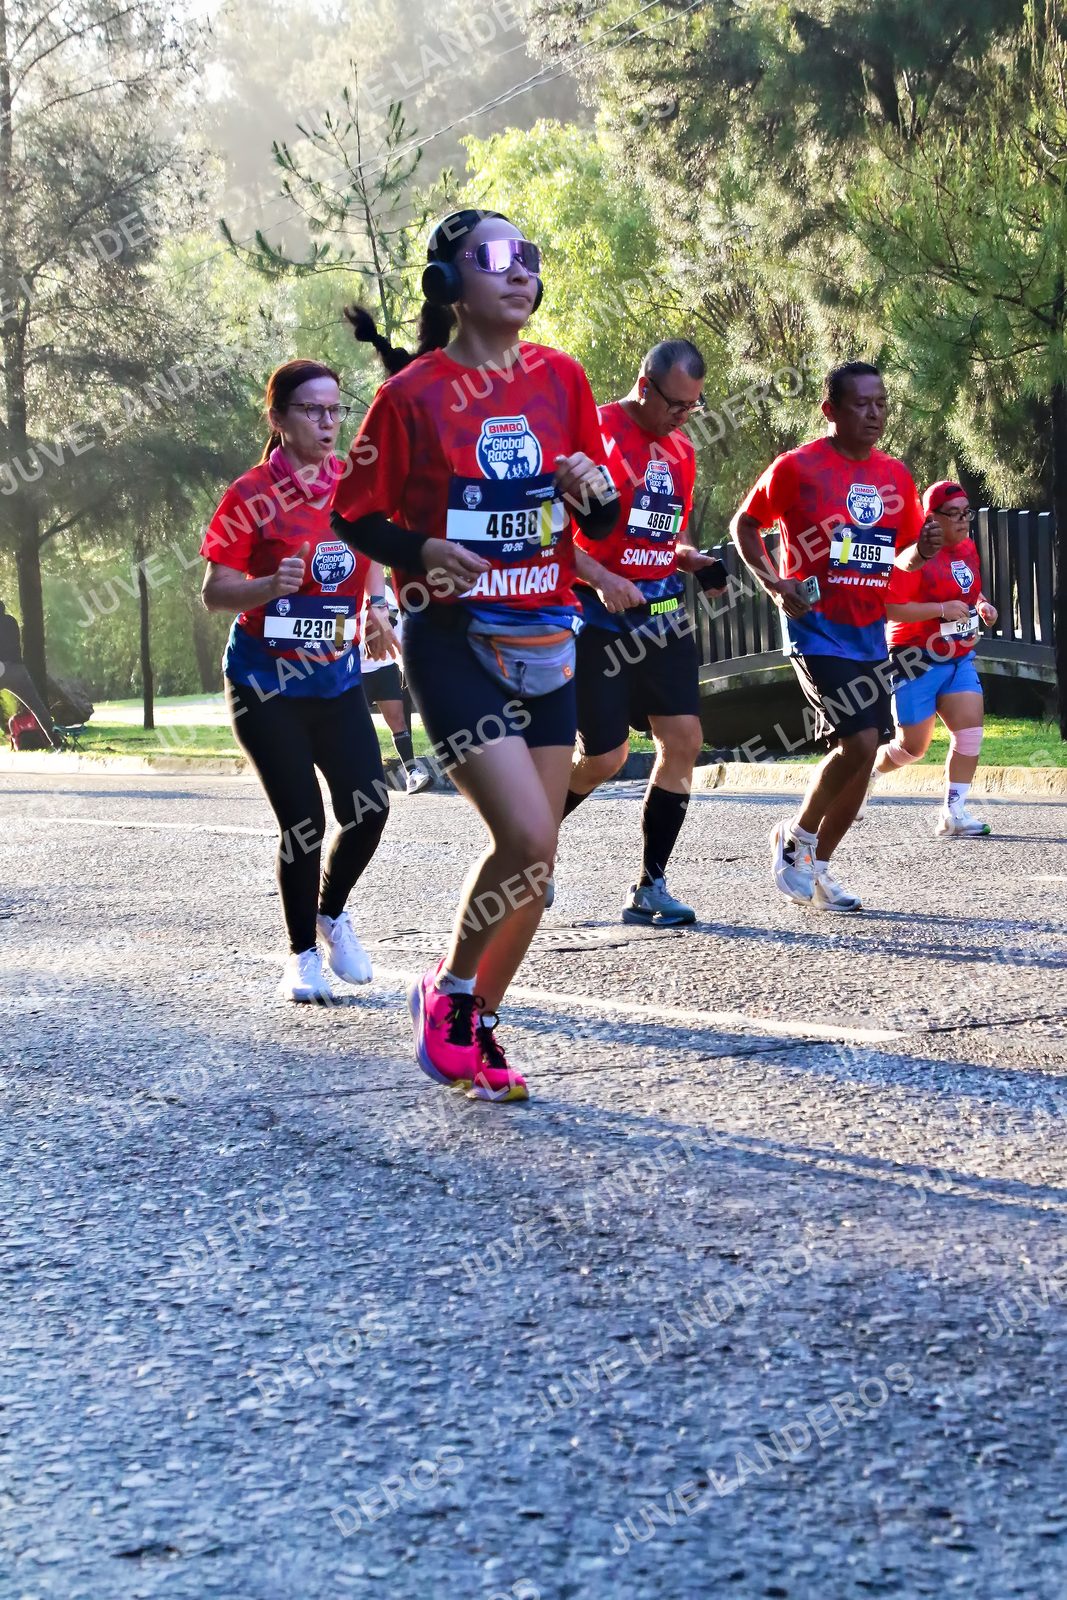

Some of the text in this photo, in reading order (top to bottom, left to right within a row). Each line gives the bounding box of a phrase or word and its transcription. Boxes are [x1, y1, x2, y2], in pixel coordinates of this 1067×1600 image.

[489, 422, 523, 434] BIMBO
[492, 437, 524, 451] Global
[487, 450, 514, 463] Race
[486, 509, 539, 539] 4638
[647, 512, 672, 531] 4860
[322, 553, 346, 564] Global
[852, 544, 882, 562] 4859
[318, 562, 337, 571] Race
[460, 562, 559, 598] ANTIAGO
[650, 597, 679, 616] PUMA
[292, 619, 333, 639] 4230
